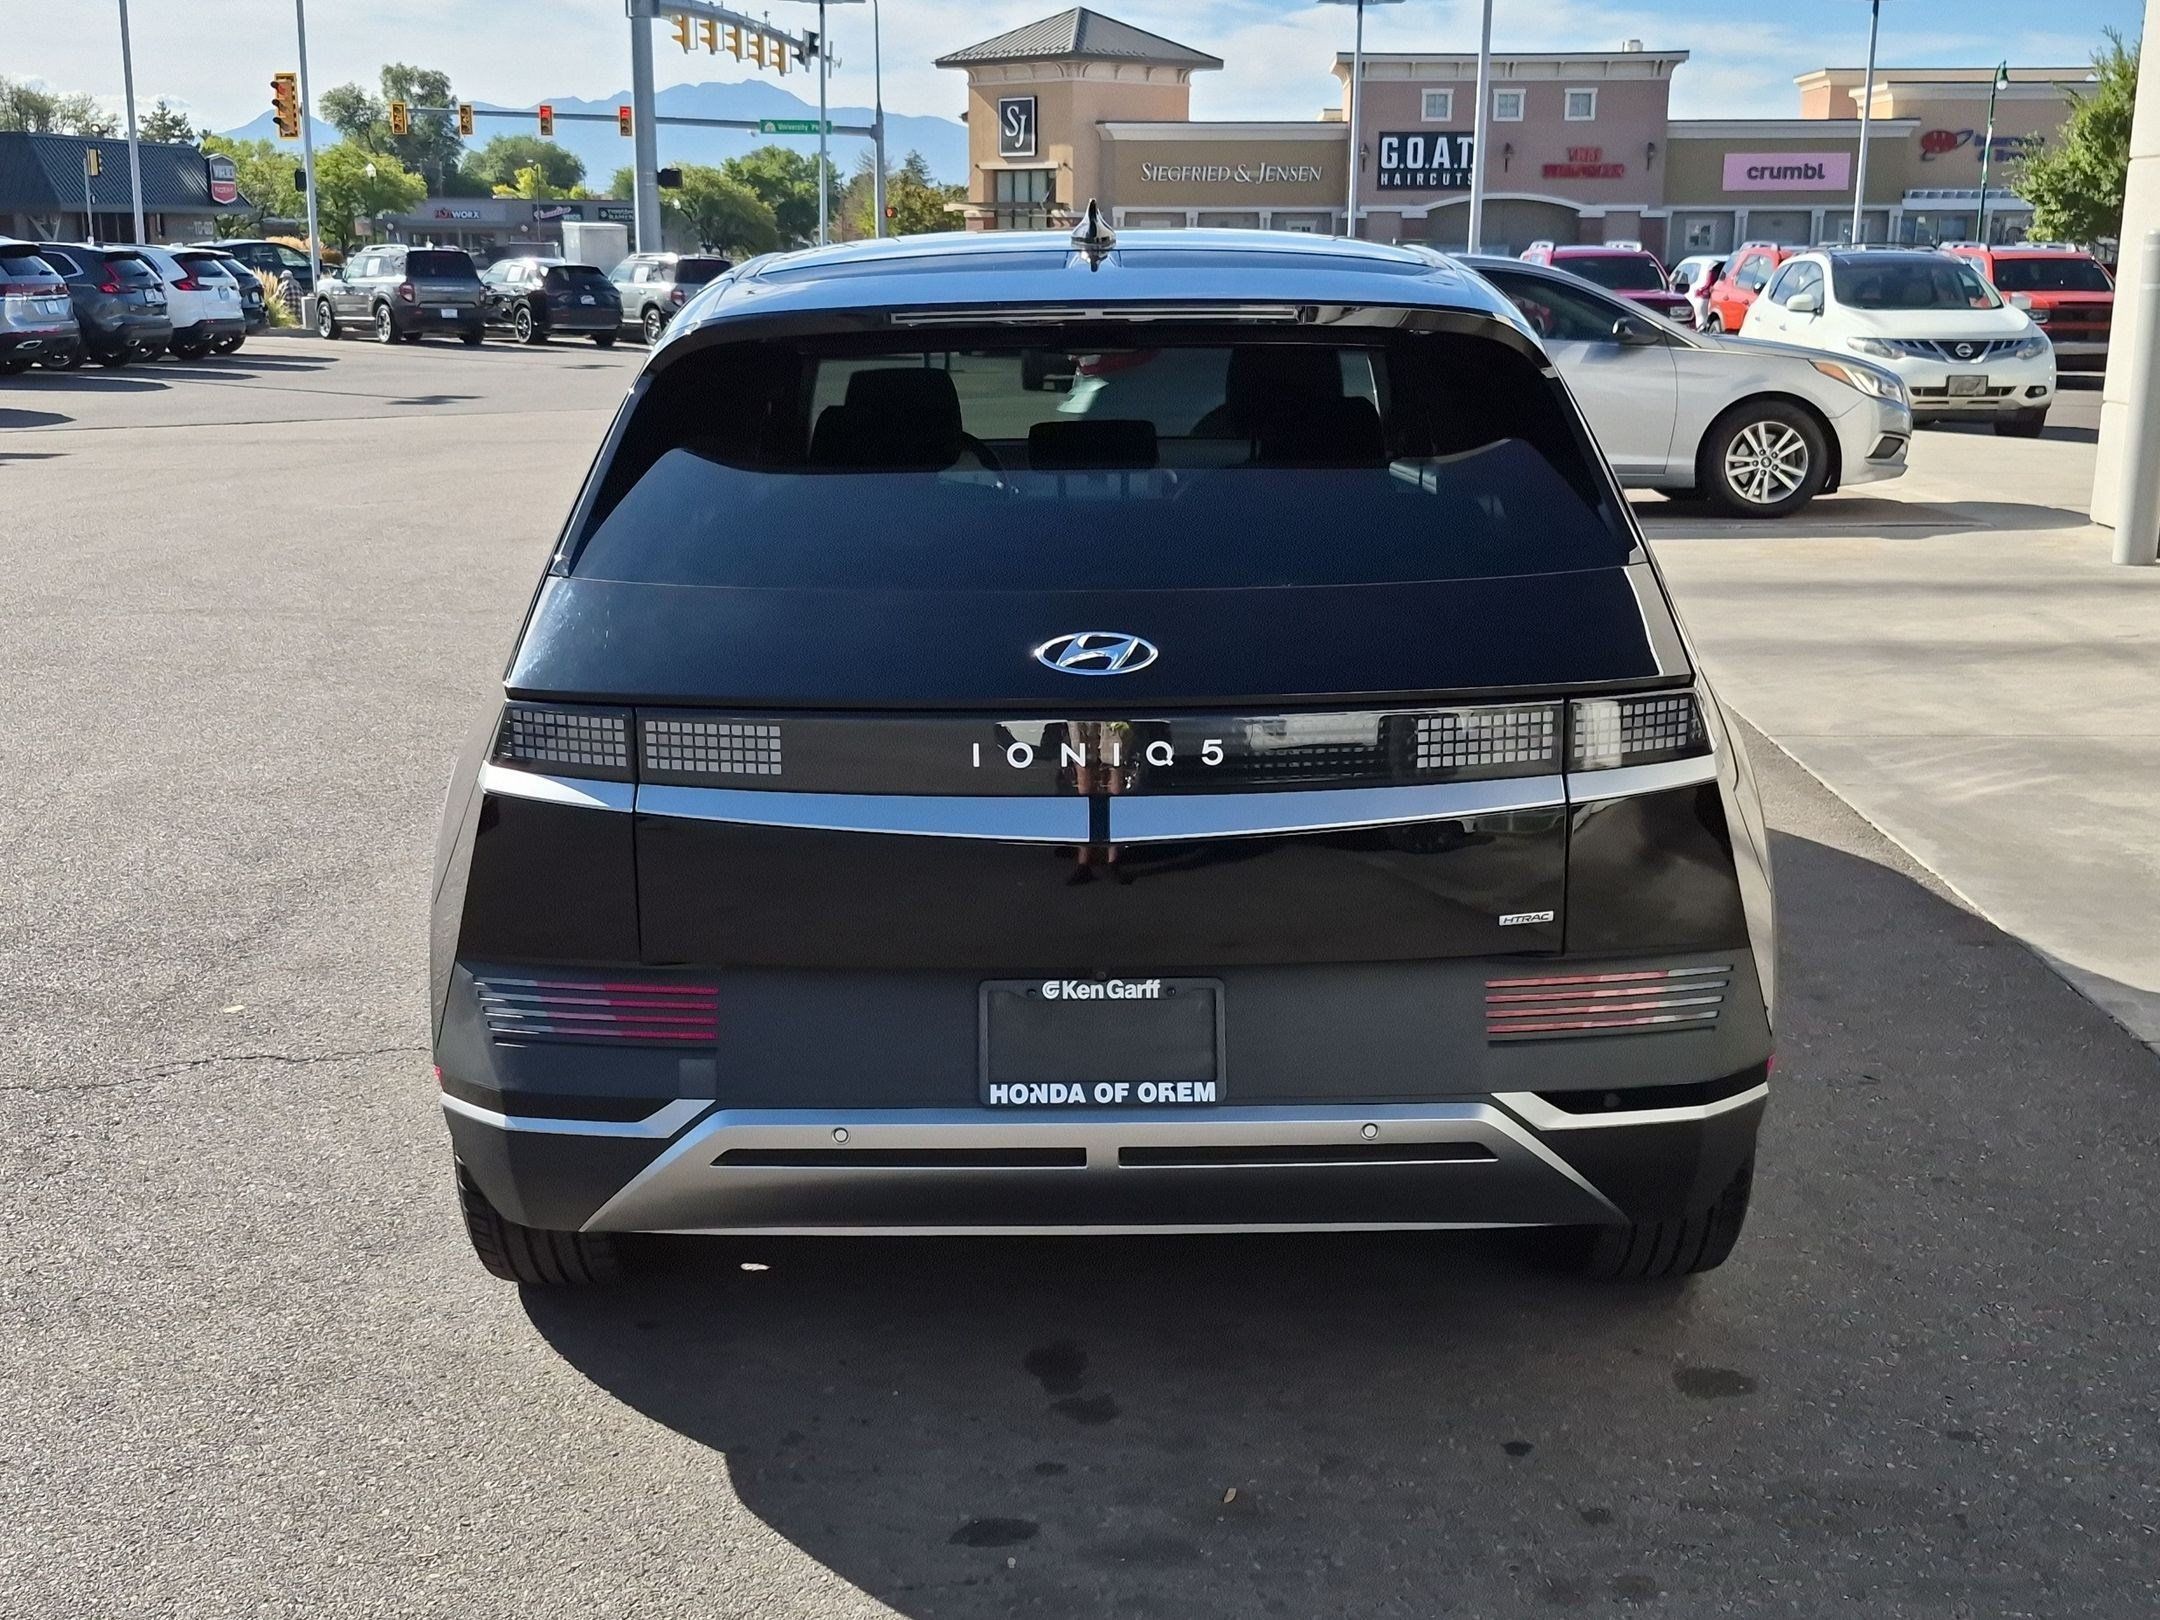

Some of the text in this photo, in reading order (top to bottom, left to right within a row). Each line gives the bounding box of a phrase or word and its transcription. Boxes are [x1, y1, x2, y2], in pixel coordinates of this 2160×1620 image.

[1234, 163, 1252, 183] &
[1380, 172, 1473, 186] HAIRCUTS
[1747, 163, 1825, 180] crumbl
[972, 739, 1224, 769] IONIQ 5
[1503, 913, 1550, 924] HTRAC
[1062, 979, 1161, 999] Ken Garff
[989, 1081, 1216, 1105] HONDA OF OREM
